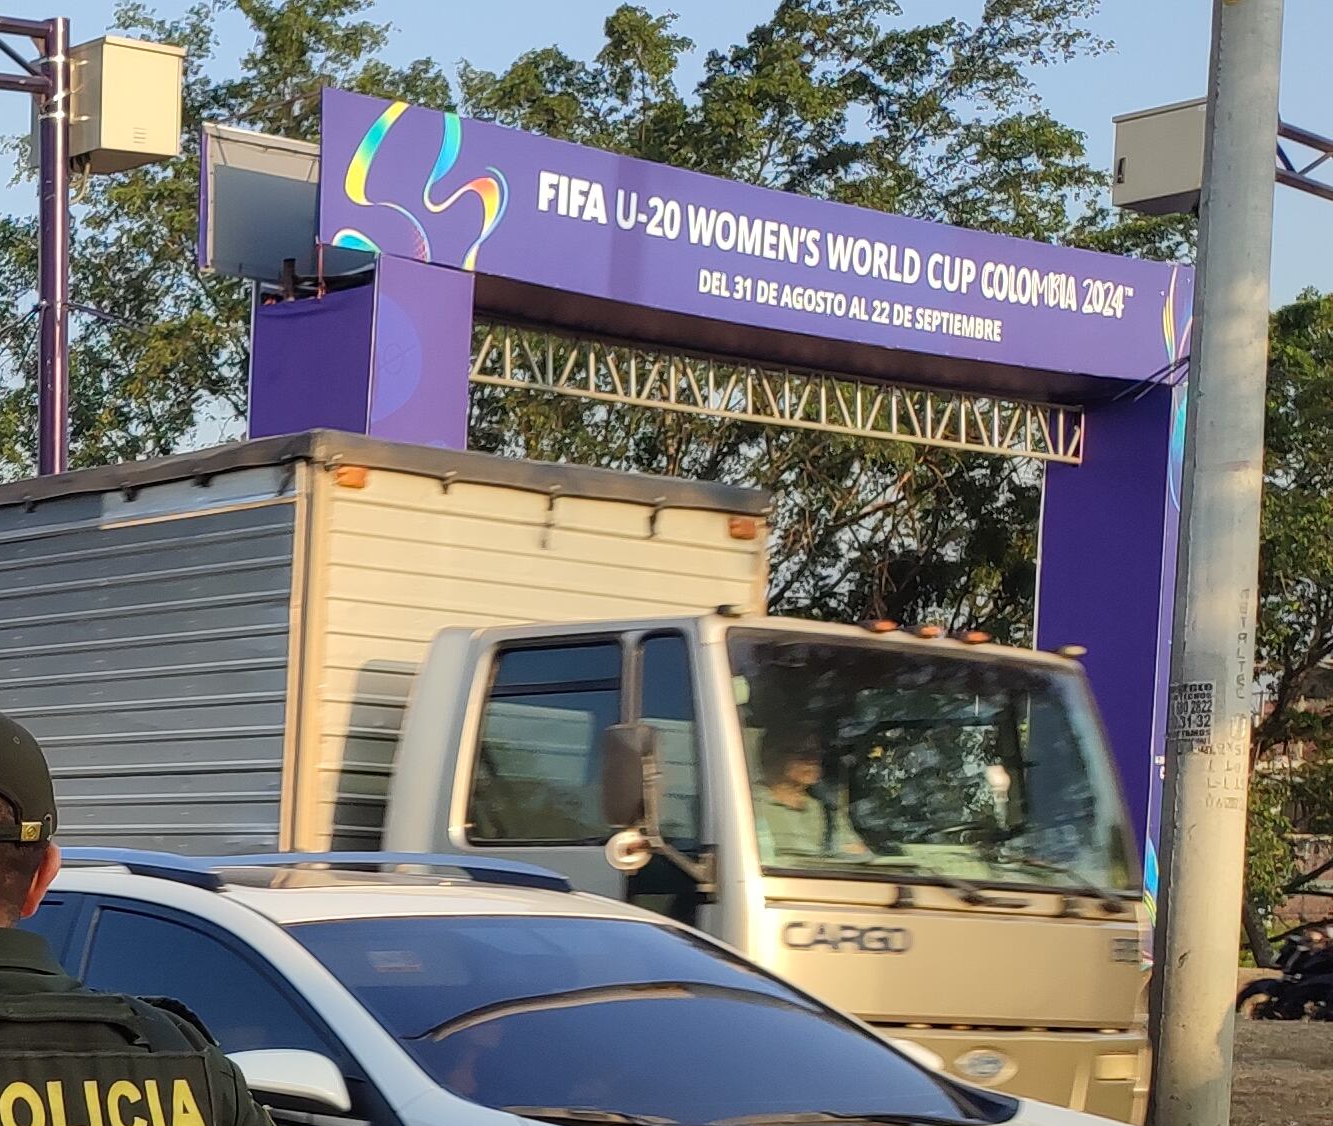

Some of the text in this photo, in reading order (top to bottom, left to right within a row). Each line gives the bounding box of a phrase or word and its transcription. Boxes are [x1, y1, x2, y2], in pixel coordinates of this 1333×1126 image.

[538, 171, 608, 225] FIFA
[616, 188, 681, 240] U-20
[687, 204, 821, 268] WOMEN'S
[826, 232, 921, 285] WORLD
[927, 252, 976, 294] CUP
[981, 261, 1077, 312] COLOMBIA
[699, 268, 1003, 342] DEL 31 DE AGOSTO AL 22 DE SEPTIEMBRE
[784, 921, 911, 953] CARGO
